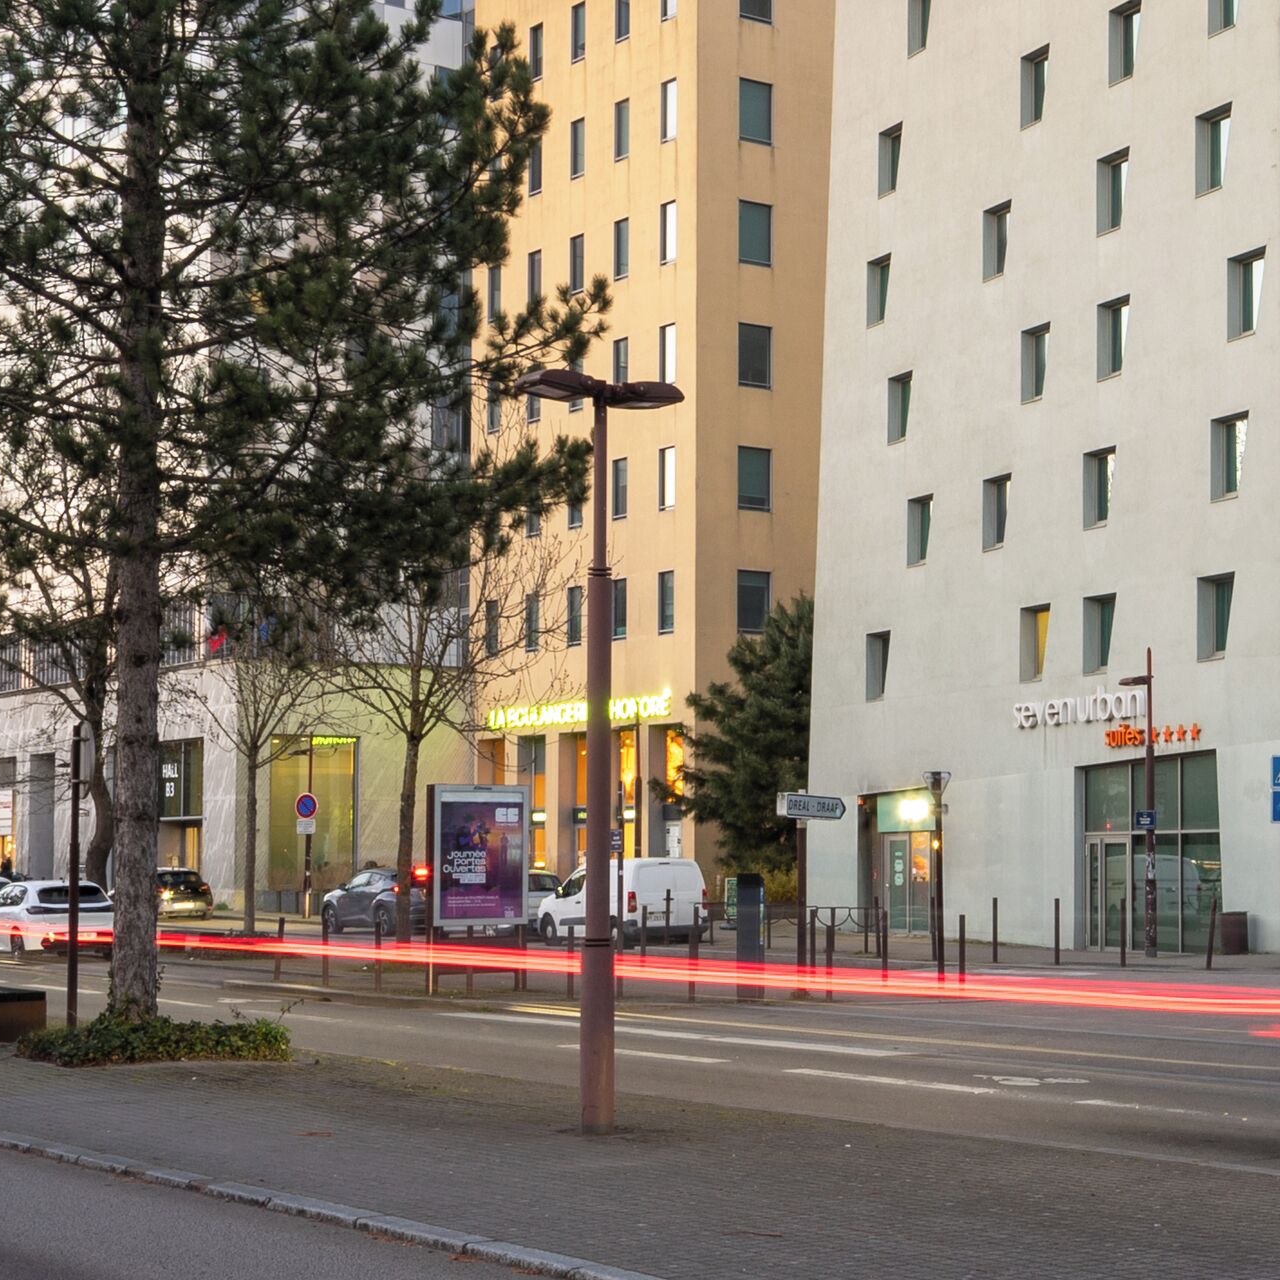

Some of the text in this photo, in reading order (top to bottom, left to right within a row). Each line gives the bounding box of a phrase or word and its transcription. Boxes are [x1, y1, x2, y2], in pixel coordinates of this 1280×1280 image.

[489, 709, 506, 730] LA
[507, 701, 589, 728] BOULANGERI
[1013, 686, 1146, 729] seven urban
[1105, 724, 1144, 747] suites
[165, 782, 175, 798] B3
[788, 799, 810, 812] DREAL
[816, 801, 839, 813] DRAAF
[447, 850, 486, 860] Journée
[442, 864, 486, 873] Ouvertes
